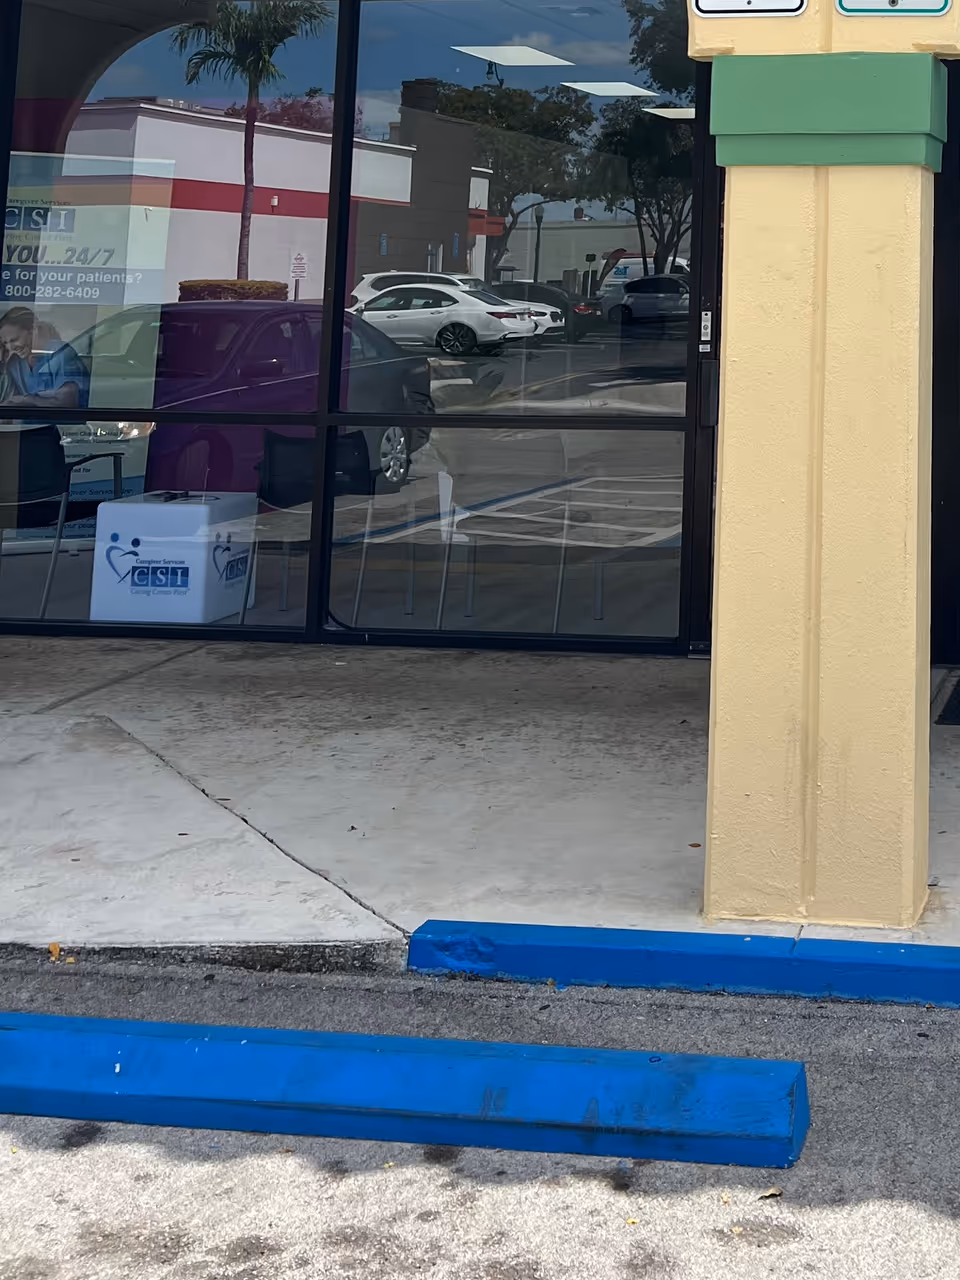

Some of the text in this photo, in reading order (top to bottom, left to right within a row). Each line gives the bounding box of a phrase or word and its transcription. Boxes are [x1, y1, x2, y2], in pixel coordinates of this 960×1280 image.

[15, 268, 36, 280] for
[40, 271, 73, 284] your
[76, 271, 143, 285] patients?
[4, 285, 100, 299] 800-282-6409
[134, 567, 183, 586] CSI
